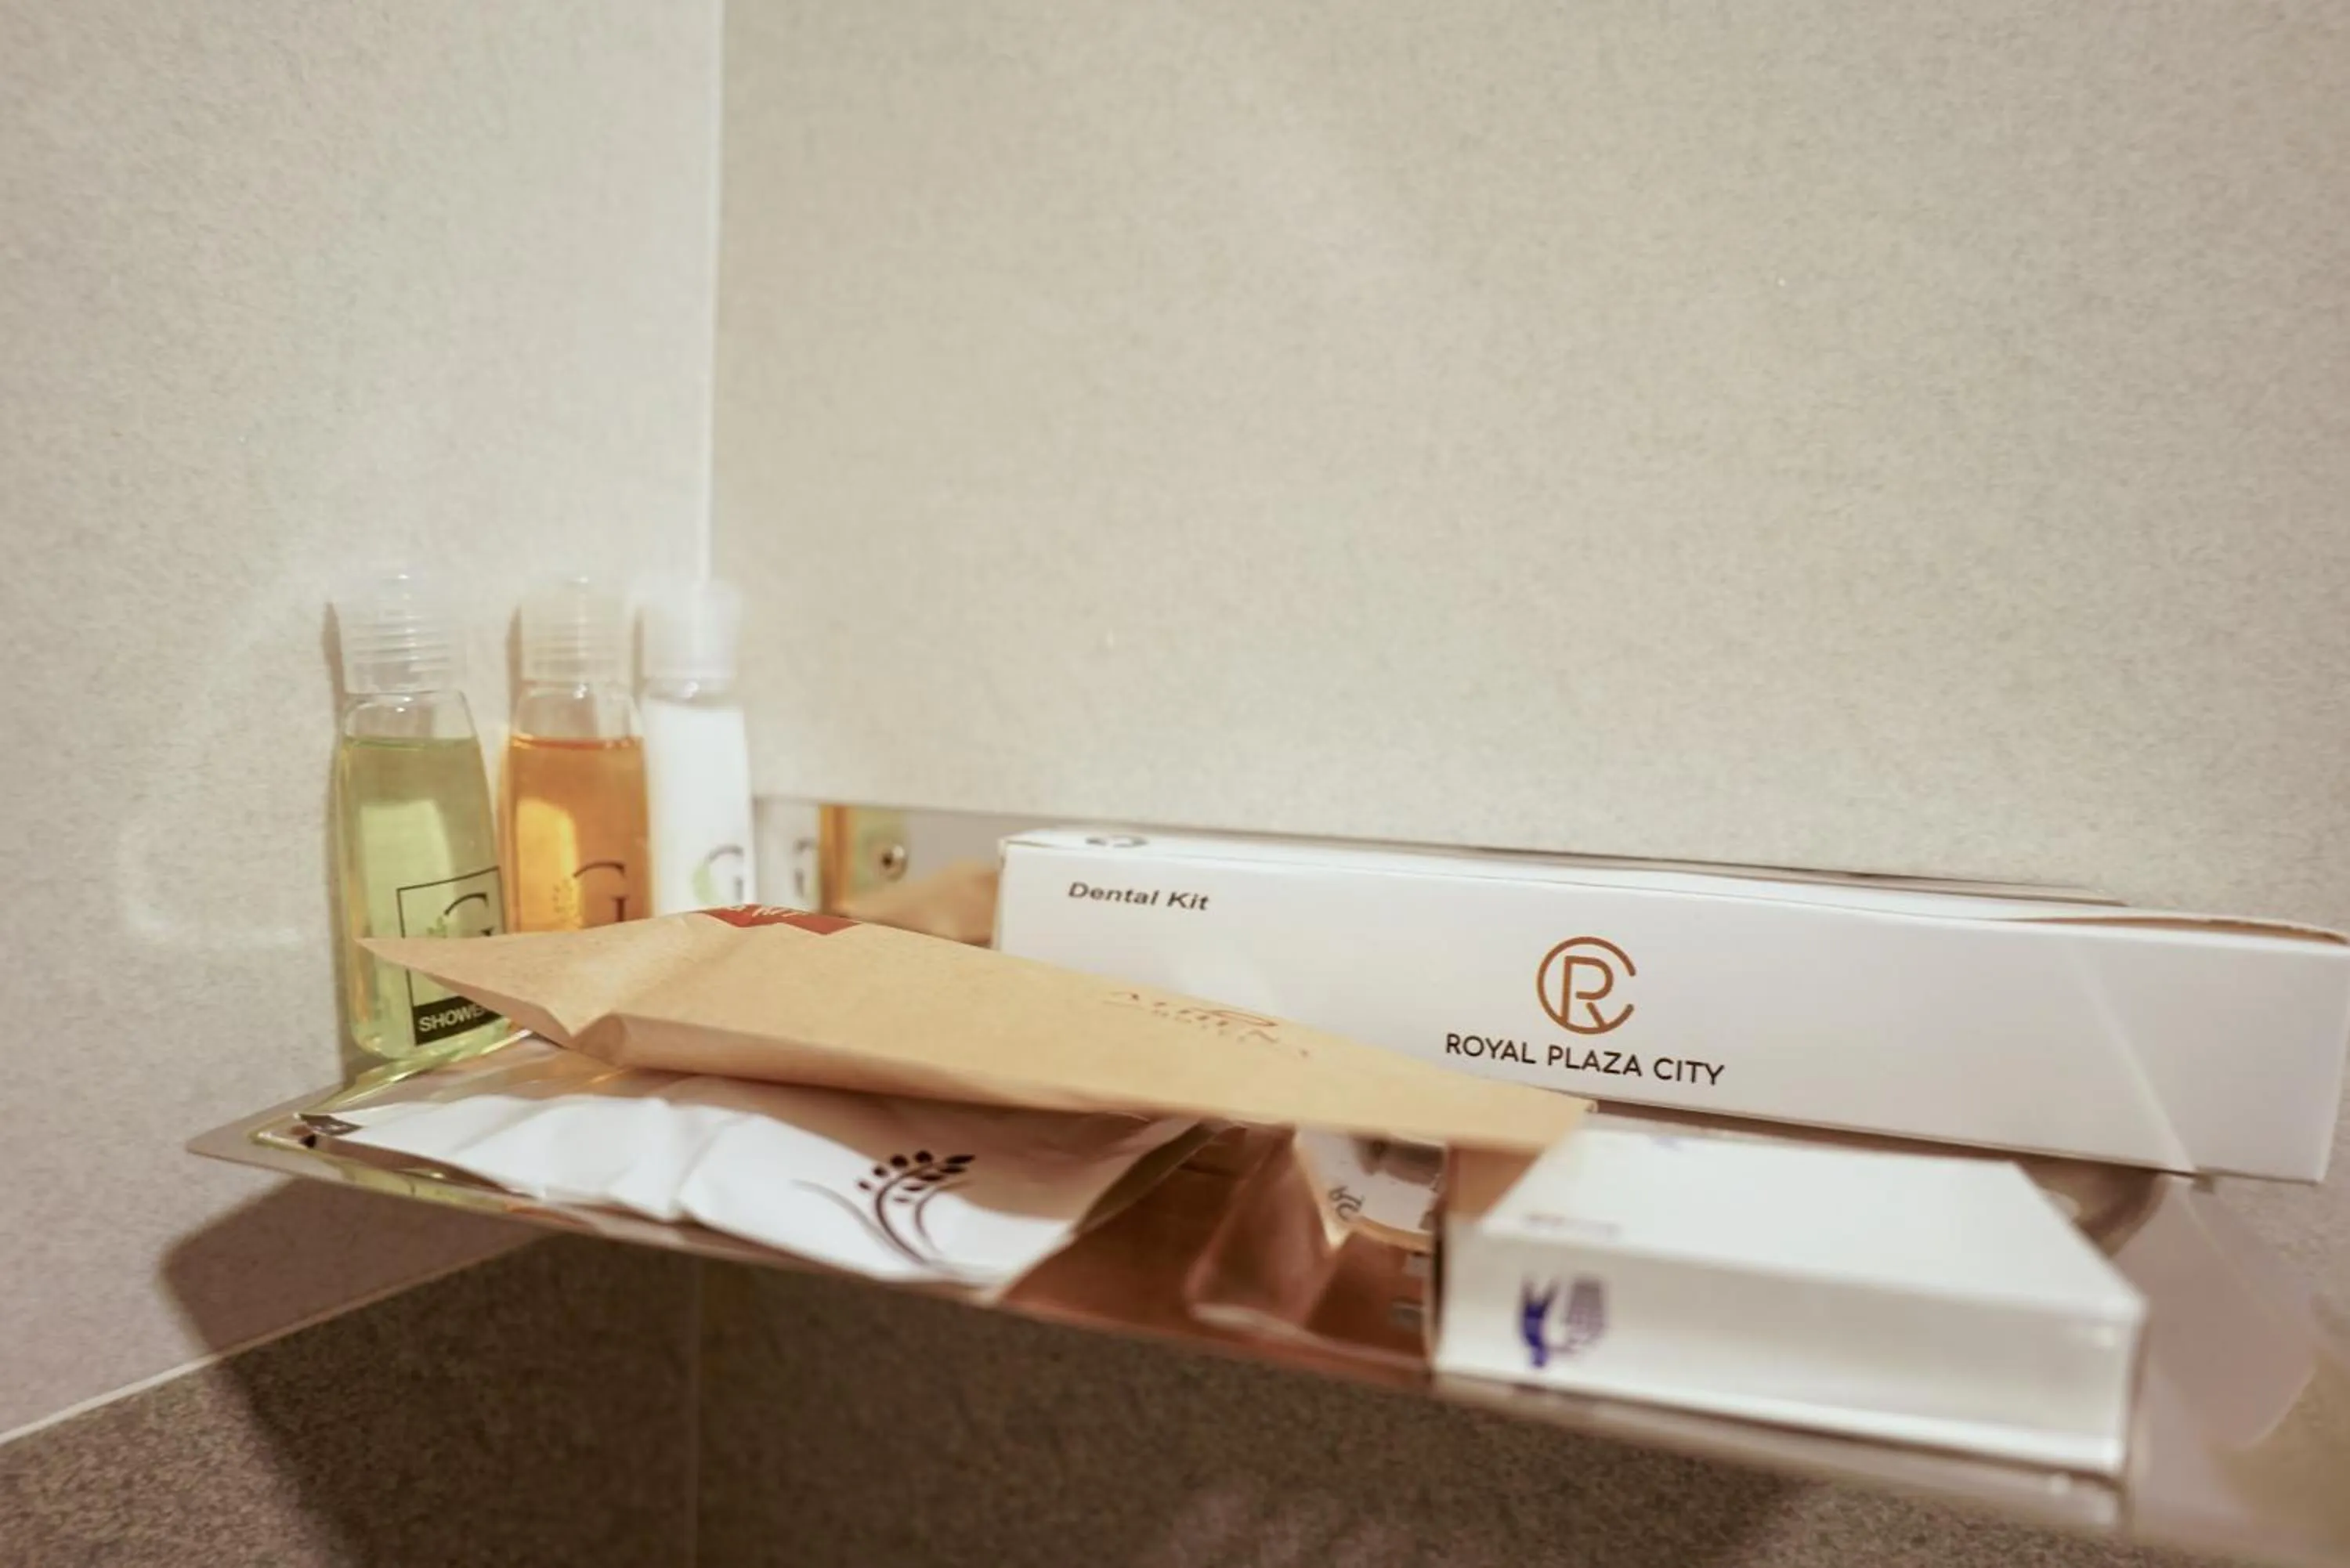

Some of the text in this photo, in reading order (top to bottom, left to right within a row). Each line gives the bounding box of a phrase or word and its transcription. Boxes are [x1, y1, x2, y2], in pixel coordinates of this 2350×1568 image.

[1068, 881, 1209, 911] Dental Kit
[418, 1003, 487, 1032] SHOWE
[1445, 1032, 1725, 1086] ROYAL PLAZA CITY
